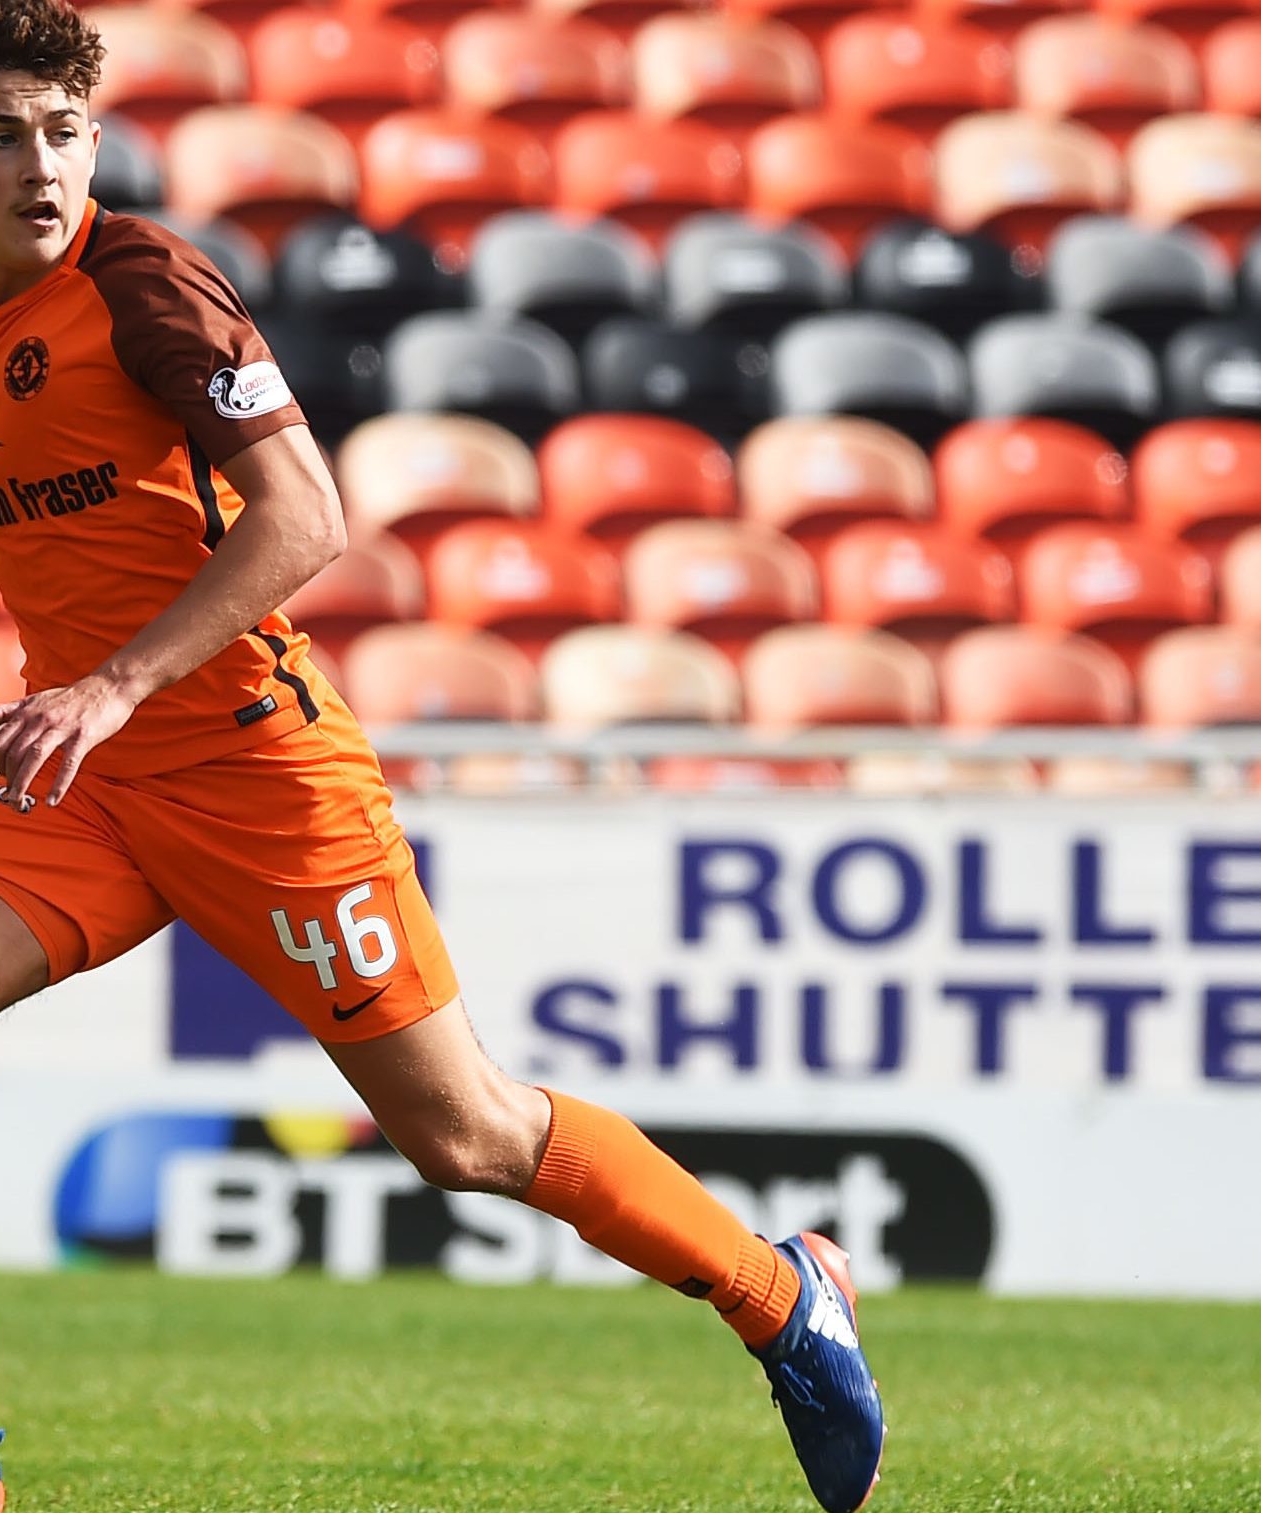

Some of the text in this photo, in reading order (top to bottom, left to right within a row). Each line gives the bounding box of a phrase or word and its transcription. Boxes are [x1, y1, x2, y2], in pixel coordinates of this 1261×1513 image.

[7, 461, 118, 521] Fraser
[270, 882, 398, 991] 46
[677, 836, 1261, 946] ROLLE
[531, 979, 1261, 1085] SHUTTE
[157, 1150, 423, 1282] BT
